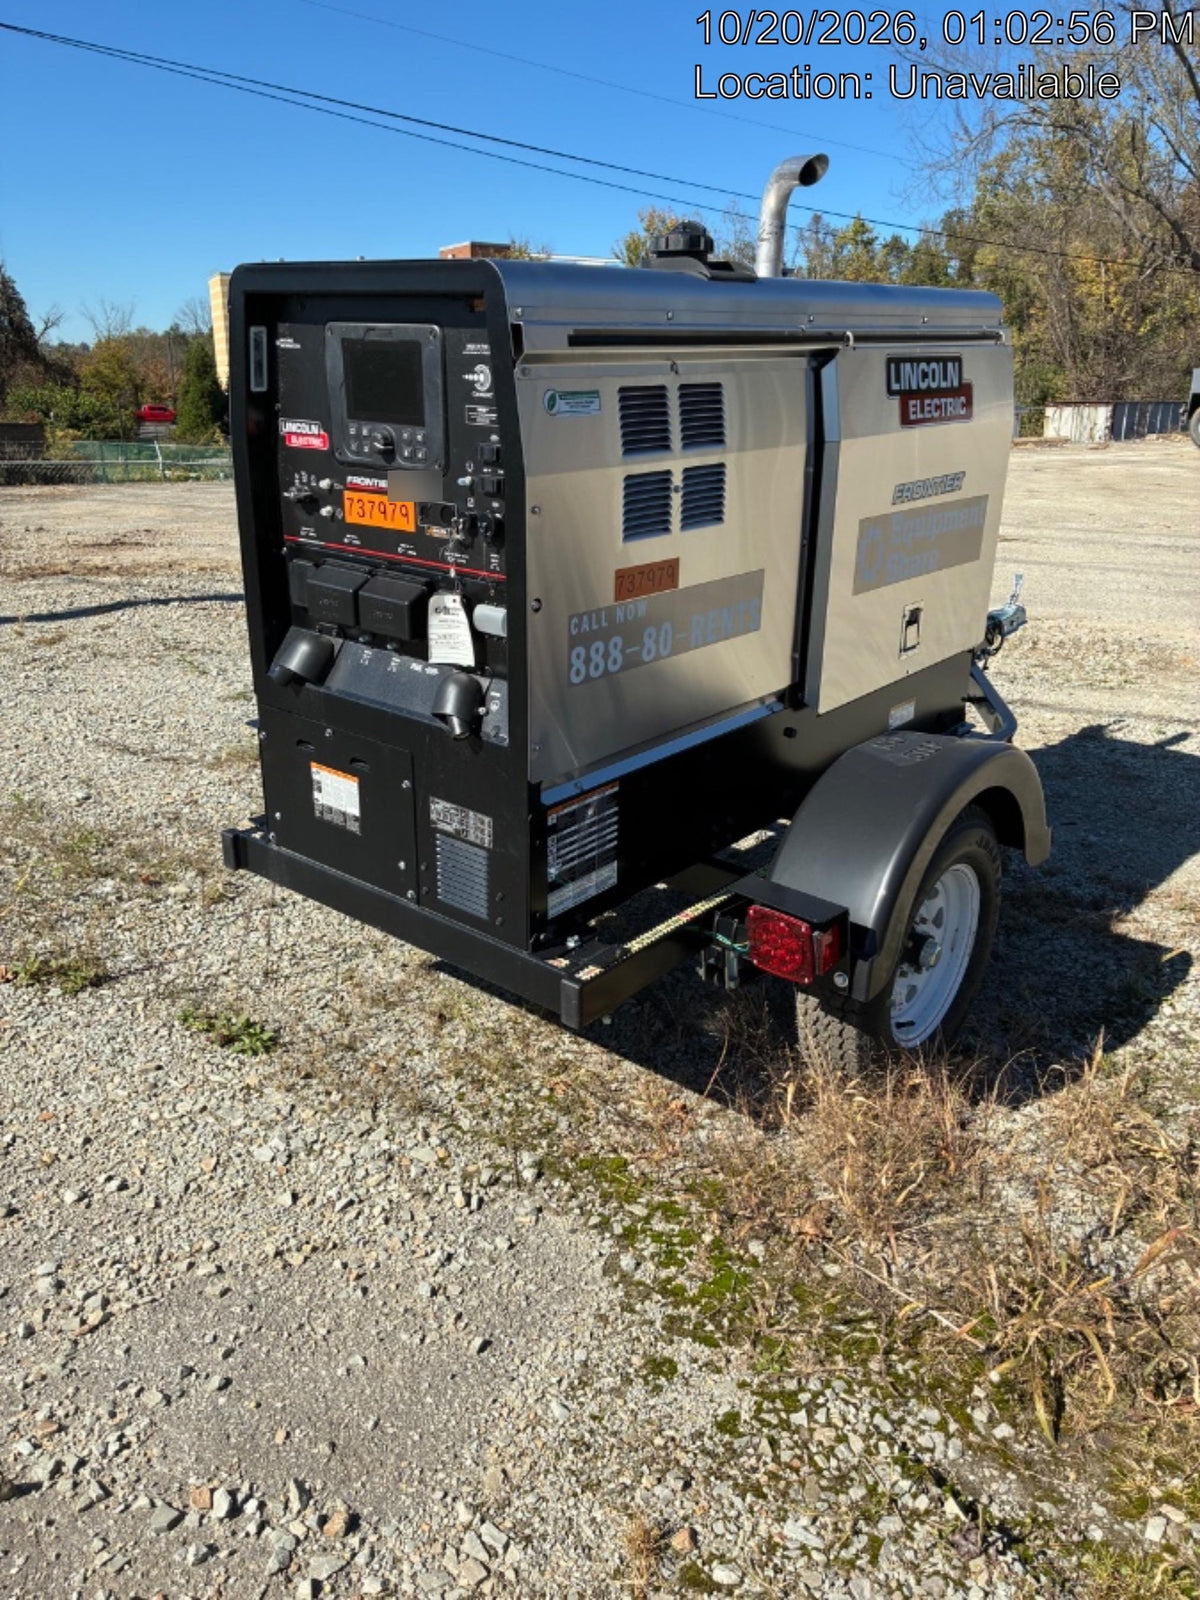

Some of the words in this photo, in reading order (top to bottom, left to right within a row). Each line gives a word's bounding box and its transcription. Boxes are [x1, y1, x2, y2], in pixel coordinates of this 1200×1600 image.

[890, 362, 959, 390] LINCOLN
[908, 397, 966, 420] ELECTRIC
[281, 422, 319, 435] LINCOLN
[346, 497, 410, 524] 737979
[617, 564, 675, 597] 737979
[570, 613, 608, 635] CALL
[616, 600, 648, 624] NOW
